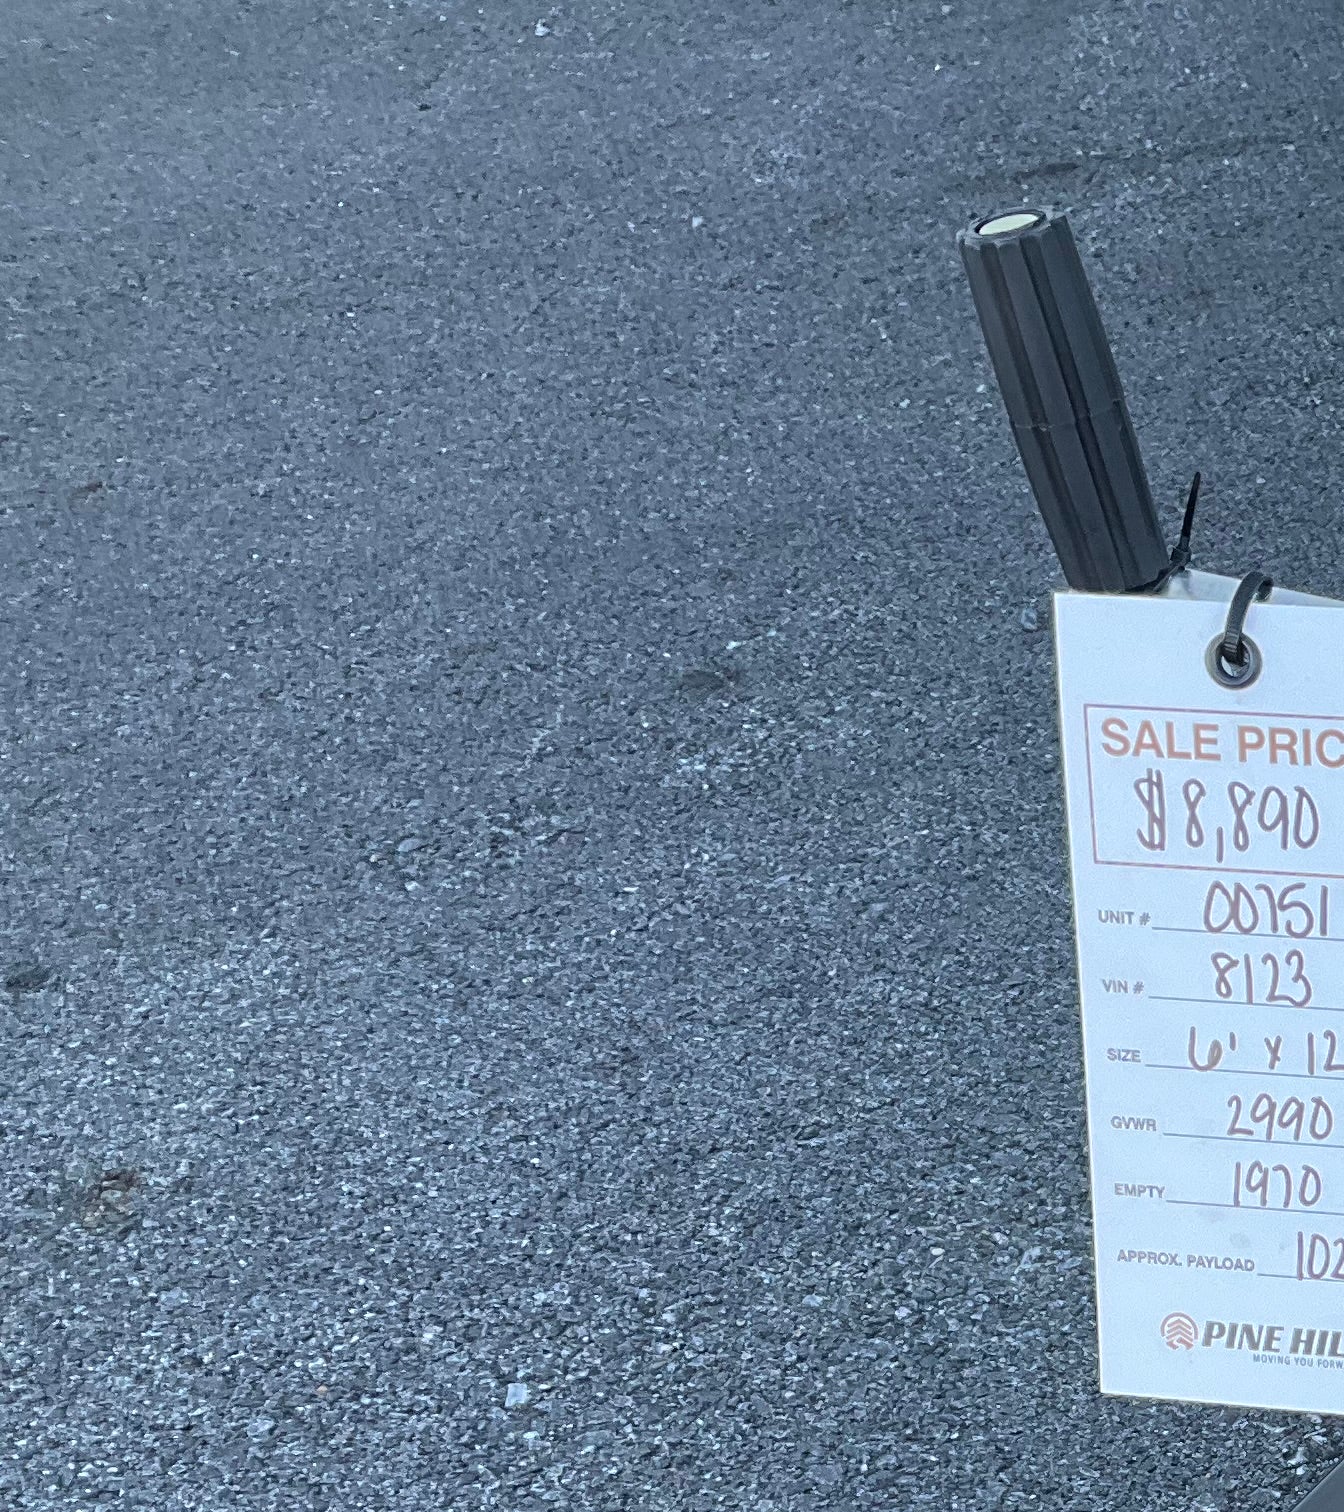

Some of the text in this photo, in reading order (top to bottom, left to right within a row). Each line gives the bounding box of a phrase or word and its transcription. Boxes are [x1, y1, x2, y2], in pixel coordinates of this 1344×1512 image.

[1101, 716, 1221, 761] SALE
[1134, 768, 1320, 863] $8,890
[1098, 880, 1329, 938] UNIT # 00751
[1102, 948, 1313, 1008] VIN # 8123
[1107, 1048, 1141, 1063] SIZE
[1111, 1093, 1333, 1142] GVWR 2990
[1114, 1160, 1322, 1208] EMPTY 1970
[1117, 1249, 1182, 1267] APPROX.
[1187, 1255, 1254, 1272] PAYLOAD
[1202, 1320, 1284, 1353] PINE
[1253, 1353, 1291, 1366] MOVING
[1294, 1357, 1314, 1367] YOU
